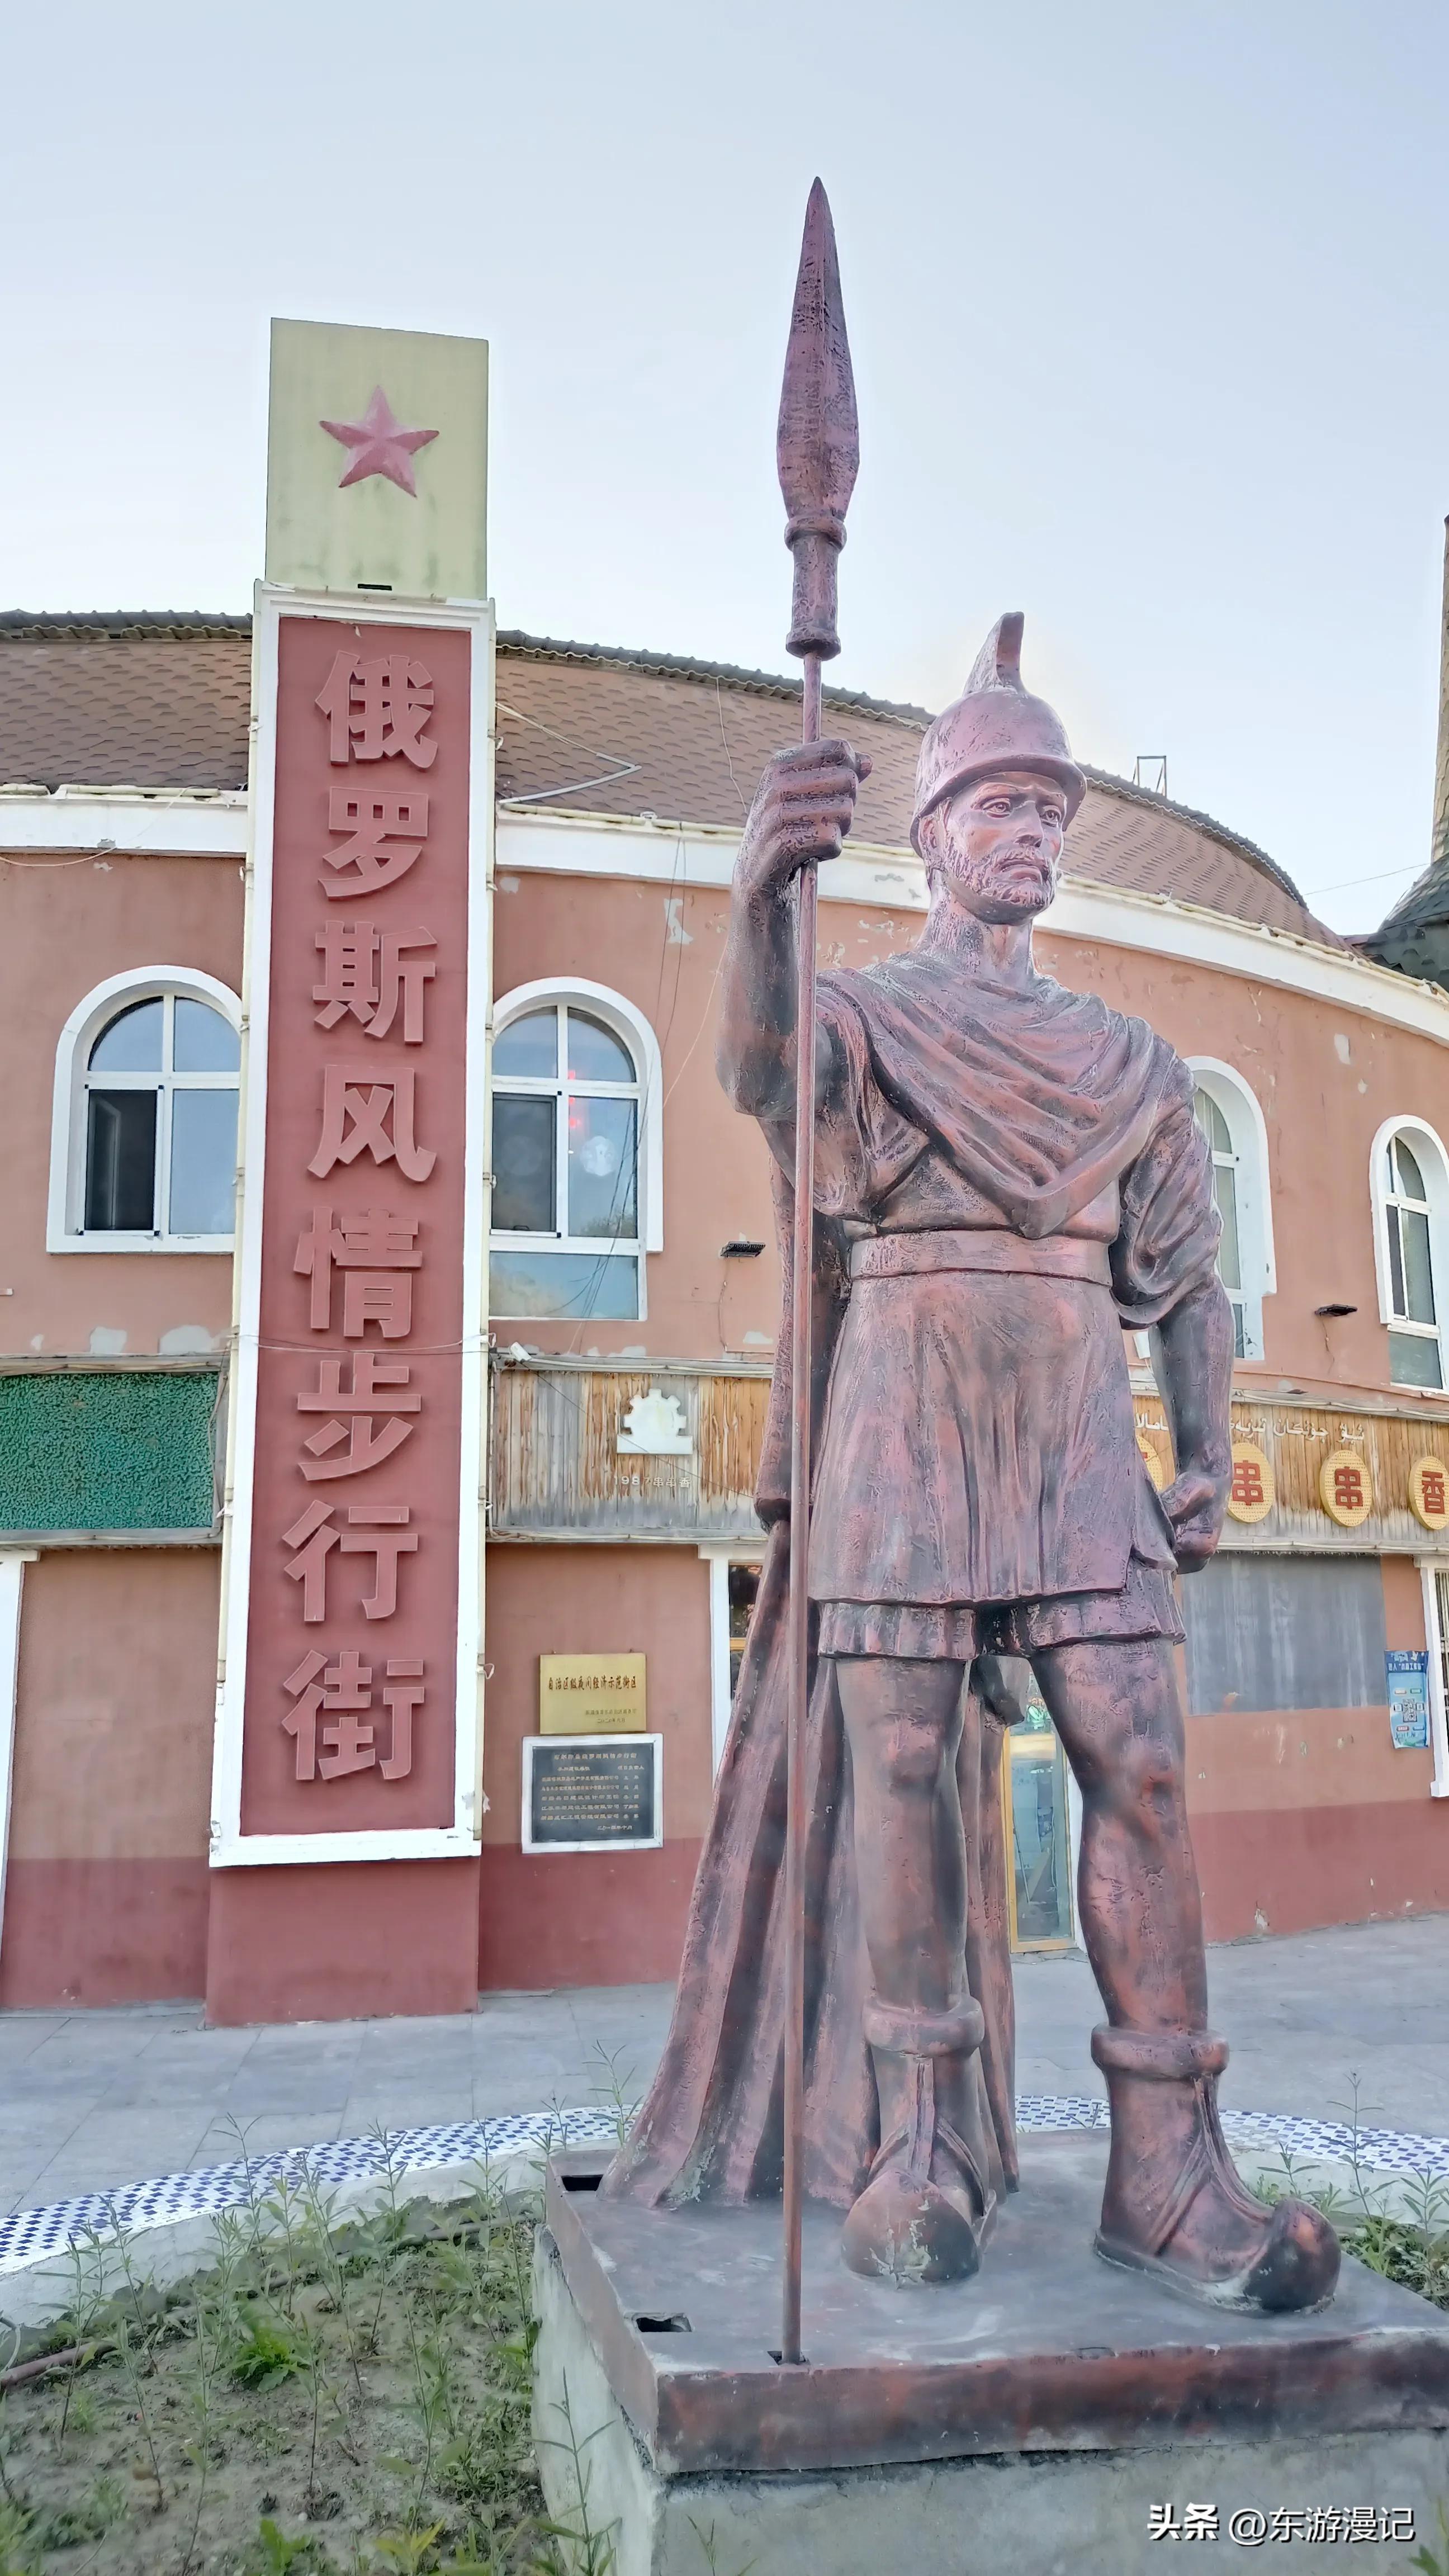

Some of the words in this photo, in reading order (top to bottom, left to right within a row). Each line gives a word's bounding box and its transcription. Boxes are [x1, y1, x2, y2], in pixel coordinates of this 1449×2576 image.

[281, 650, 438, 1780] 俄罗斯风情步行街
[548, 1674, 637, 1690] 自治区级夜间经济示范街区
